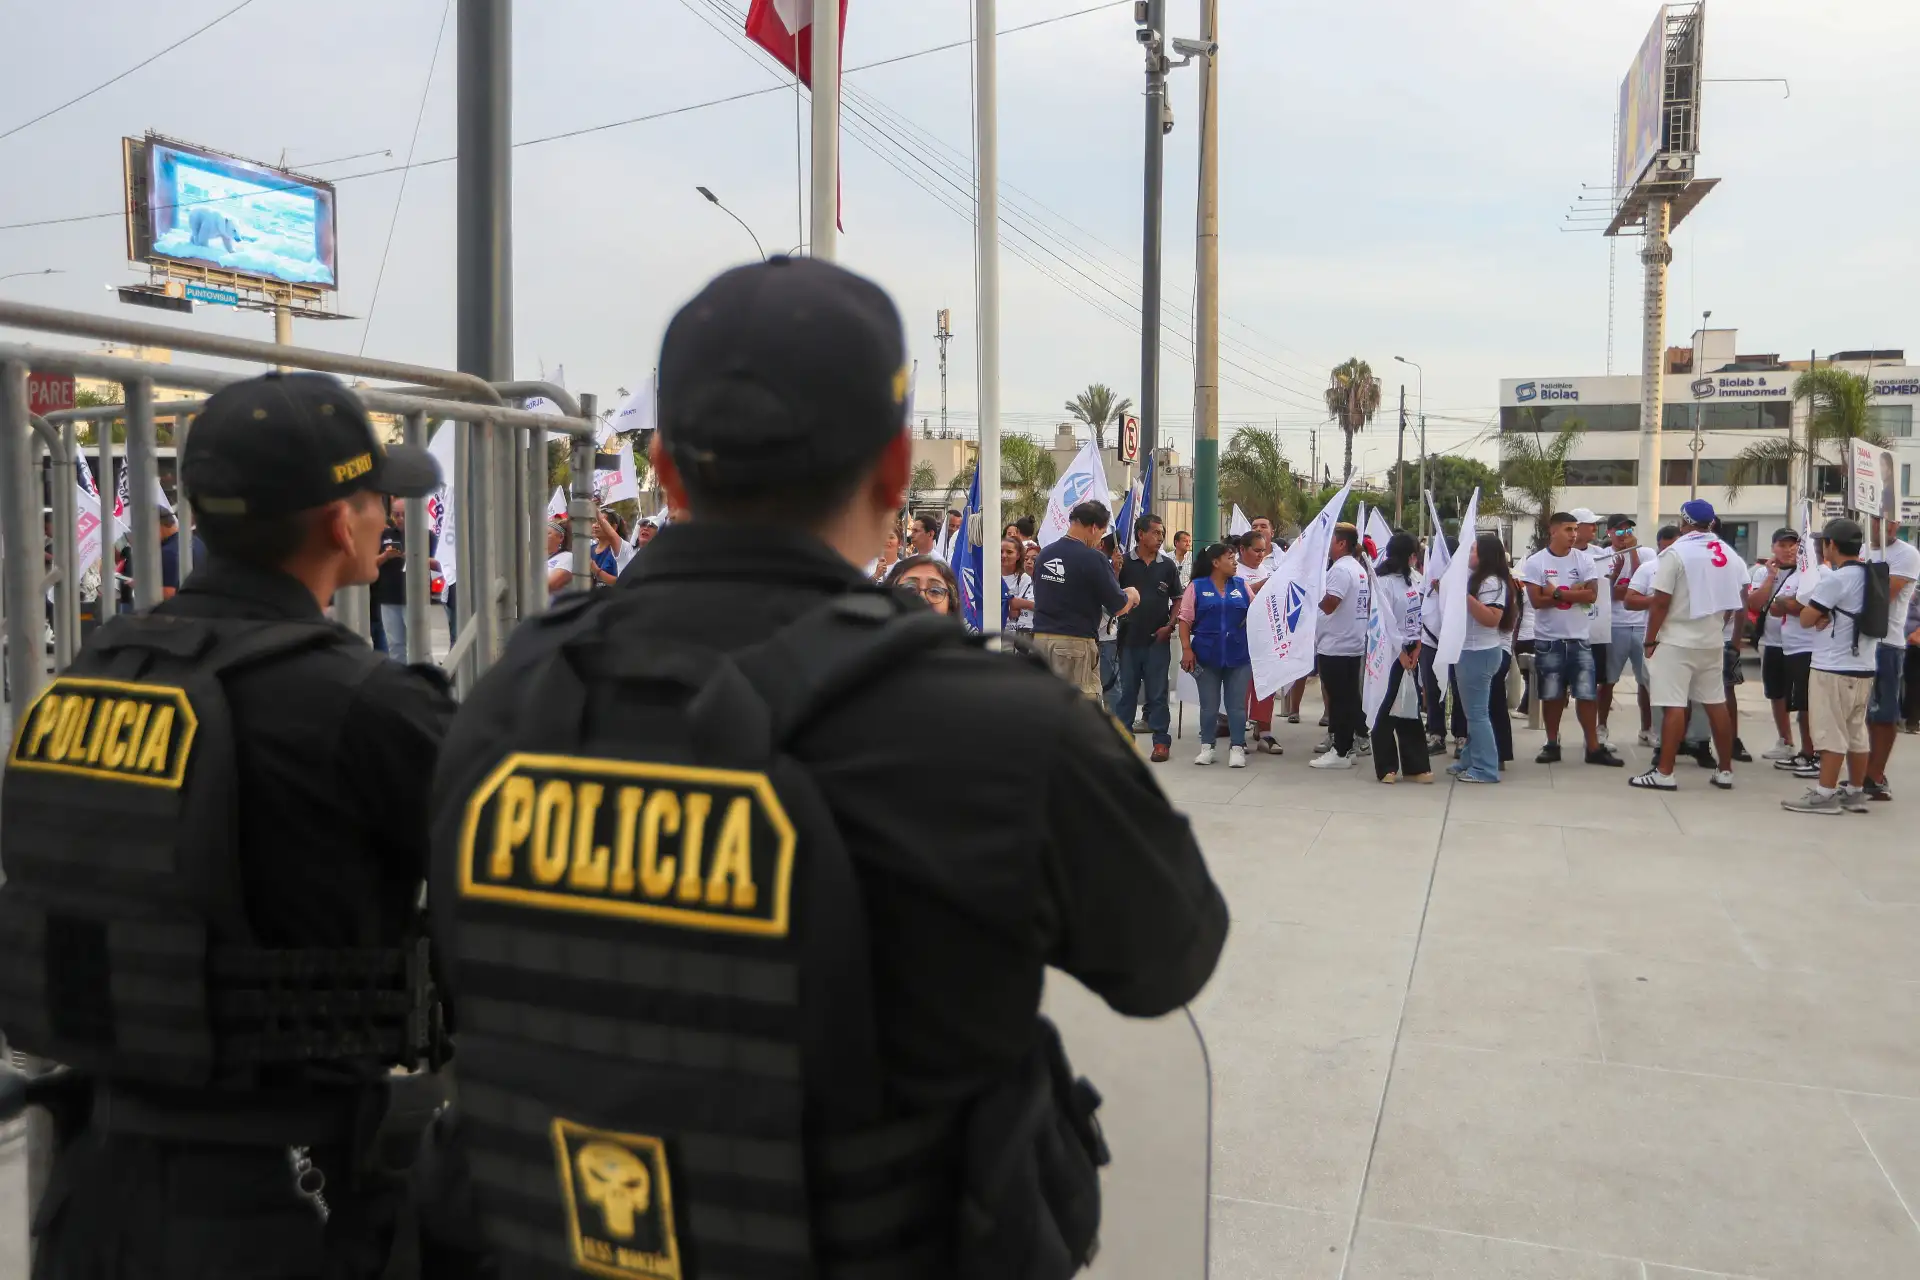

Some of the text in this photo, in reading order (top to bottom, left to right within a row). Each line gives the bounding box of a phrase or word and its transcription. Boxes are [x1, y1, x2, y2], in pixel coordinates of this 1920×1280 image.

[187, 288, 236, 303] PUNTOVISUAL
[28, 380, 72, 405] PARE
[1719, 378, 1767, 387] Biolab &
[1719, 387, 1787, 396] Inmunomed
[1873, 384, 1920, 395] ADMED
[1541, 389, 1579, 401] Biolaq
[1707, 541, 1728, 567] 3
[1270, 594, 1280, 624] AVANZA
[28, 694, 176, 773] POLICIA
[488, 775, 757, 909] POLICIA
